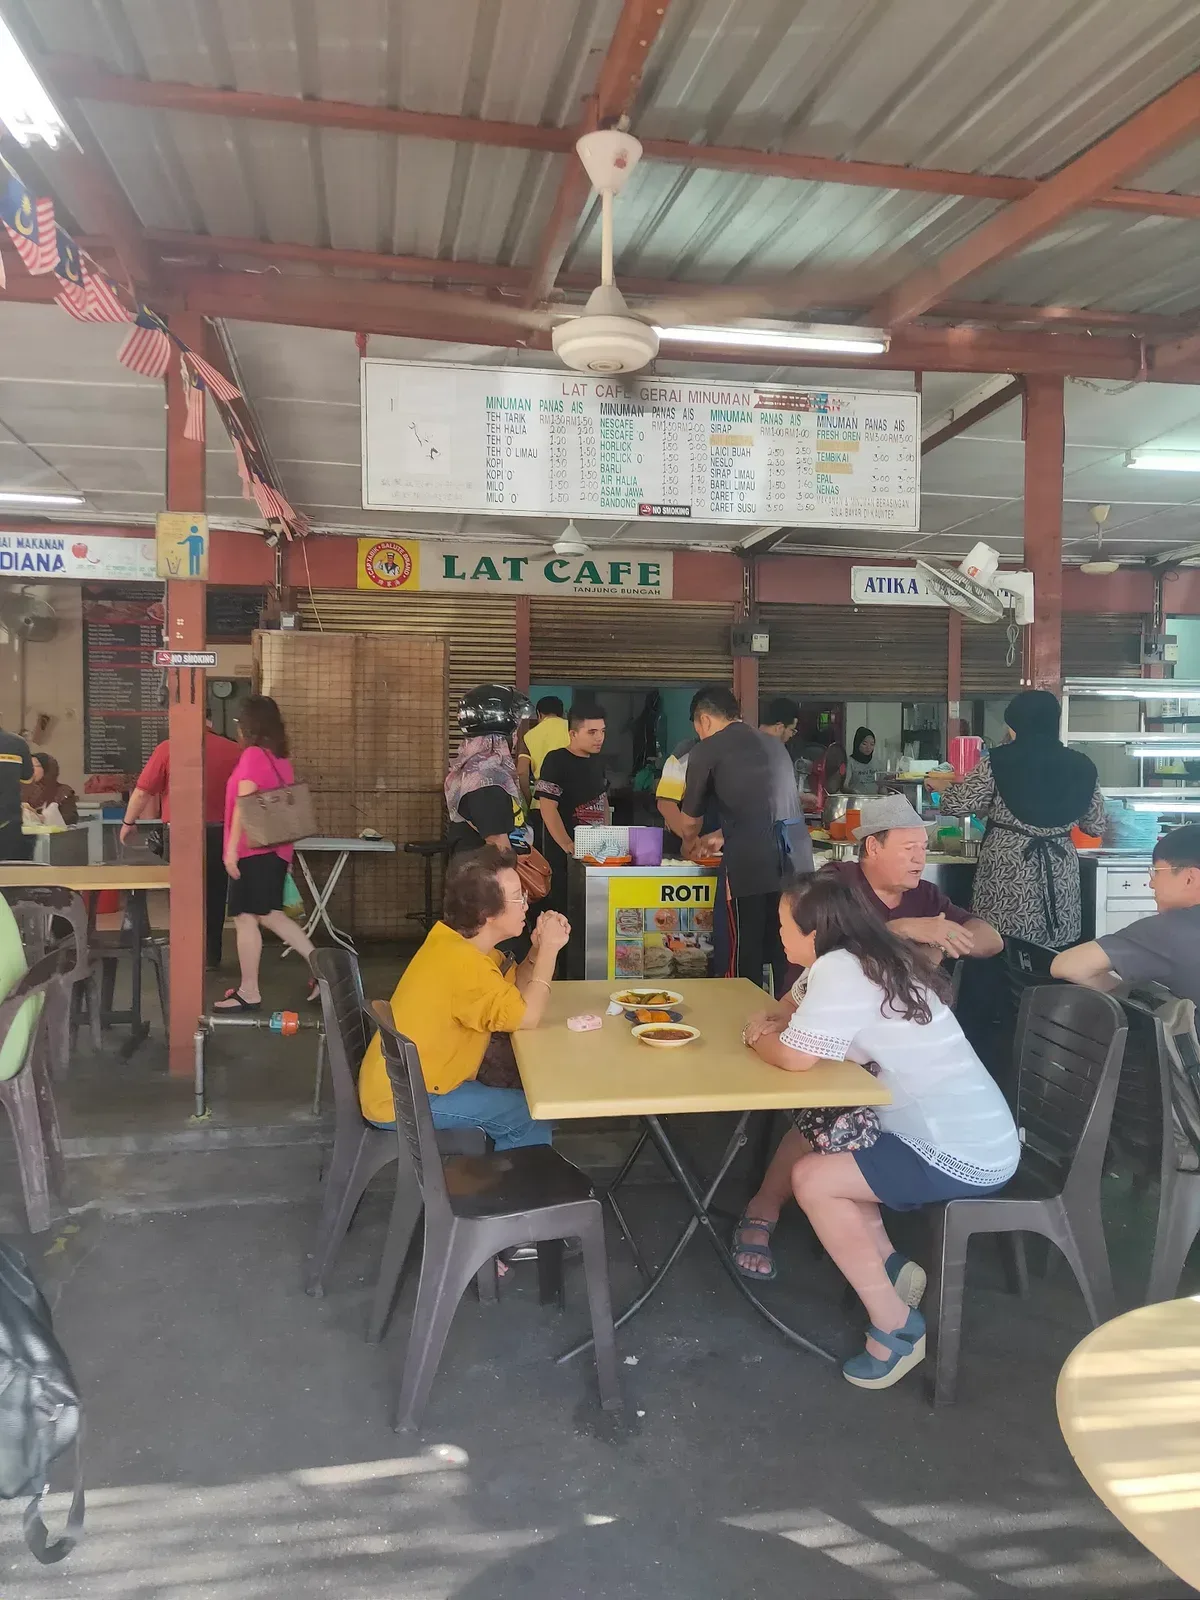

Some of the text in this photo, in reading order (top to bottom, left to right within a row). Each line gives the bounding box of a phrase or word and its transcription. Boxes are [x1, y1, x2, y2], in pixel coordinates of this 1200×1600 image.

[562, 383, 588, 396] LAT
[595, 385, 631, 399] CAFE
[640, 388, 681, 402] GERAI
[689, 391, 750, 406] MINUMAN
[486, 396, 583, 414] MINUMAN PANAS AIS
[600, 402, 694, 420] MINUMAN PANAS AIS
[486, 412, 501, 422] TEH
[505, 412, 526, 423] TARIK
[710, 409, 801, 426] MINUMAN PANAS AIS
[486, 423, 501, 433] TEH
[504, 424, 527, 435] HALIA
[600, 418, 634, 430] NESCAFE
[710, 424, 732, 434] SIRAP
[817, 415, 905, 432] MINUMAN PANAS AIS
[486, 435, 501, 445] TEH
[600, 429, 634, 440] NESCAFE
[817, 430, 839, 440] FRESH
[842, 431, 860, 441] OREN
[600, 441, 632, 452] HORLICK
[710, 447, 729, 457] LAICI
[732, 448, 751, 457] BUAH
[486, 446, 501, 457] TEH
[515, 448, 538, 459] LIMAU
[600, 452, 632, 463] HORLICK
[817, 452, 849, 462] TEMBIKAI
[486, 458, 504, 469] KOPI
[710, 457, 733, 467] NESLO
[600, 463, 622, 474] BARLI
[710, 469, 731, 479] SIRAP
[734, 470, 755, 479] LIMAU
[486, 470, 503, 480] KOPI
[600, 475, 614, 485] AIR
[616, 476, 638, 486] HALIA
[817, 474, 833, 484] EPAL
[486, 481, 504, 492] MILO
[710, 480, 731, 490] BARLI
[735, 481, 755, 491] LIMAU
[817, 485, 840, 495] NENAS
[486, 492, 504, 503] MILO
[600, 486, 621, 497] ASAM
[625, 487, 644, 498] JAWA
[710, 491, 734, 501] CARET
[600, 497, 636, 508] BANDONG
[710, 502, 734, 513] CARET
[737, 503, 756, 513] SUSU
[653, 506, 690, 516] NO SMOKING
[16, 538, 64, 550] MAKANAN
[0, 552, 65, 572] DIANA
[381, 543, 411, 576] SALUTE BRAND
[442, 554, 660, 586] LAT CAFE
[573, 586, 618, 594] TANJUNG
[864, 577, 919, 595] ATIKA
[172, 655, 215, 664] NO SMOKING
[661, 885, 710, 902] ROTI
